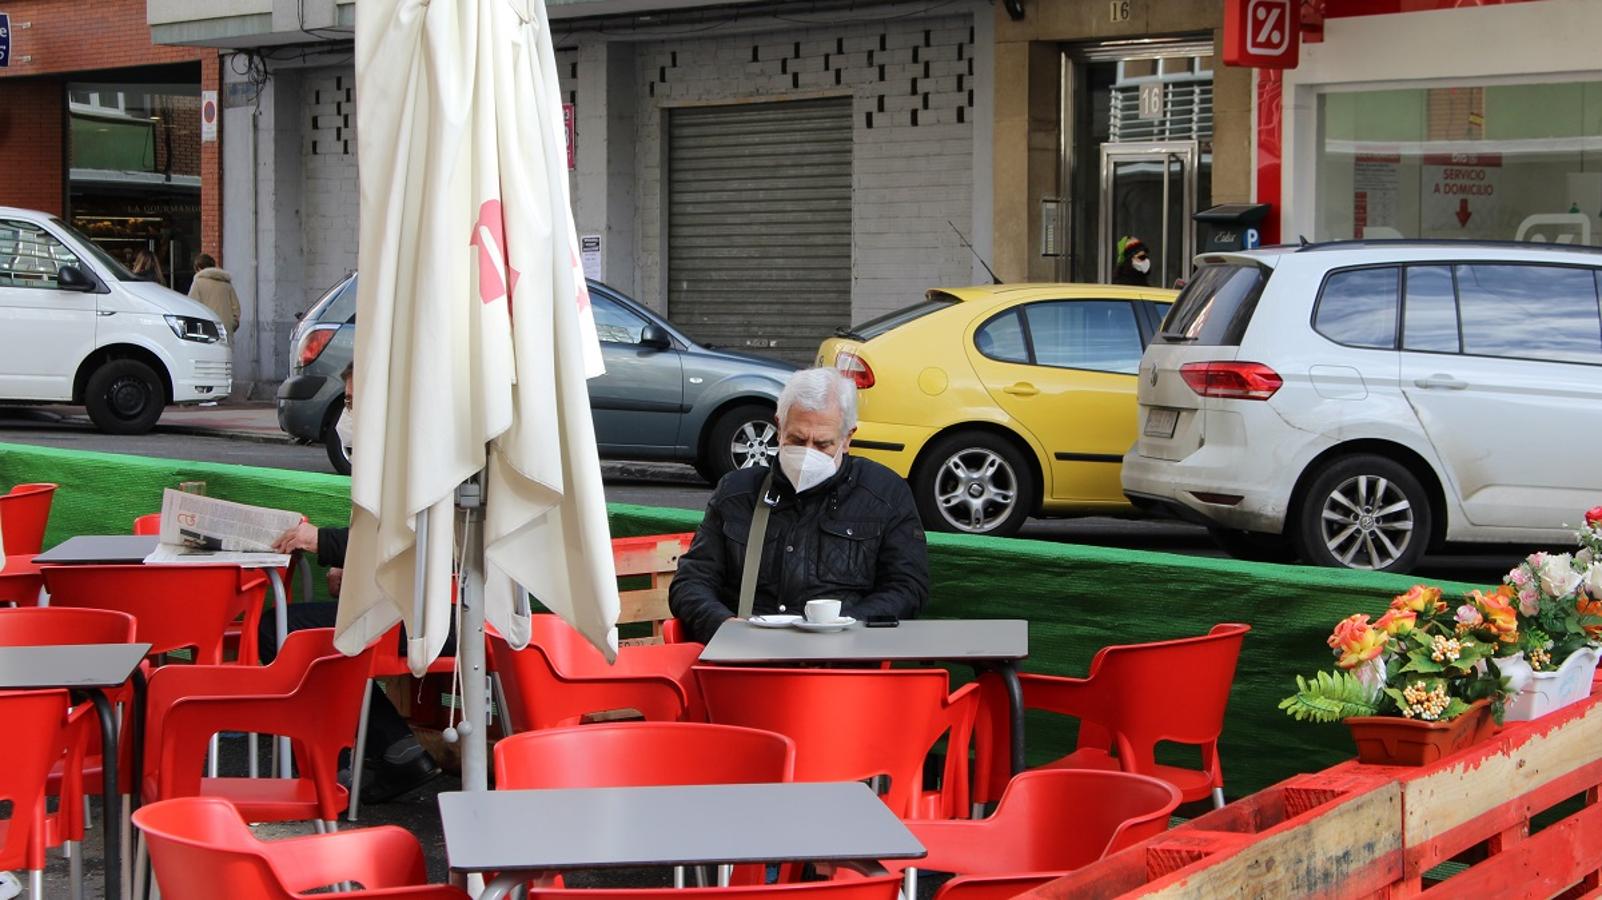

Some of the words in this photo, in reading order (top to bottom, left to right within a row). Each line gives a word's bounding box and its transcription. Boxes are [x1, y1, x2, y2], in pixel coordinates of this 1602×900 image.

[1112, 2, 1129, 21] 16
[1142, 87, 1160, 114] 16
[1443, 168, 1486, 181] SERVICIO
[1433, 182, 1441, 194] A
[1443, 183, 1494, 196] DOMICILIO
[1247, 228, 1259, 249] P
